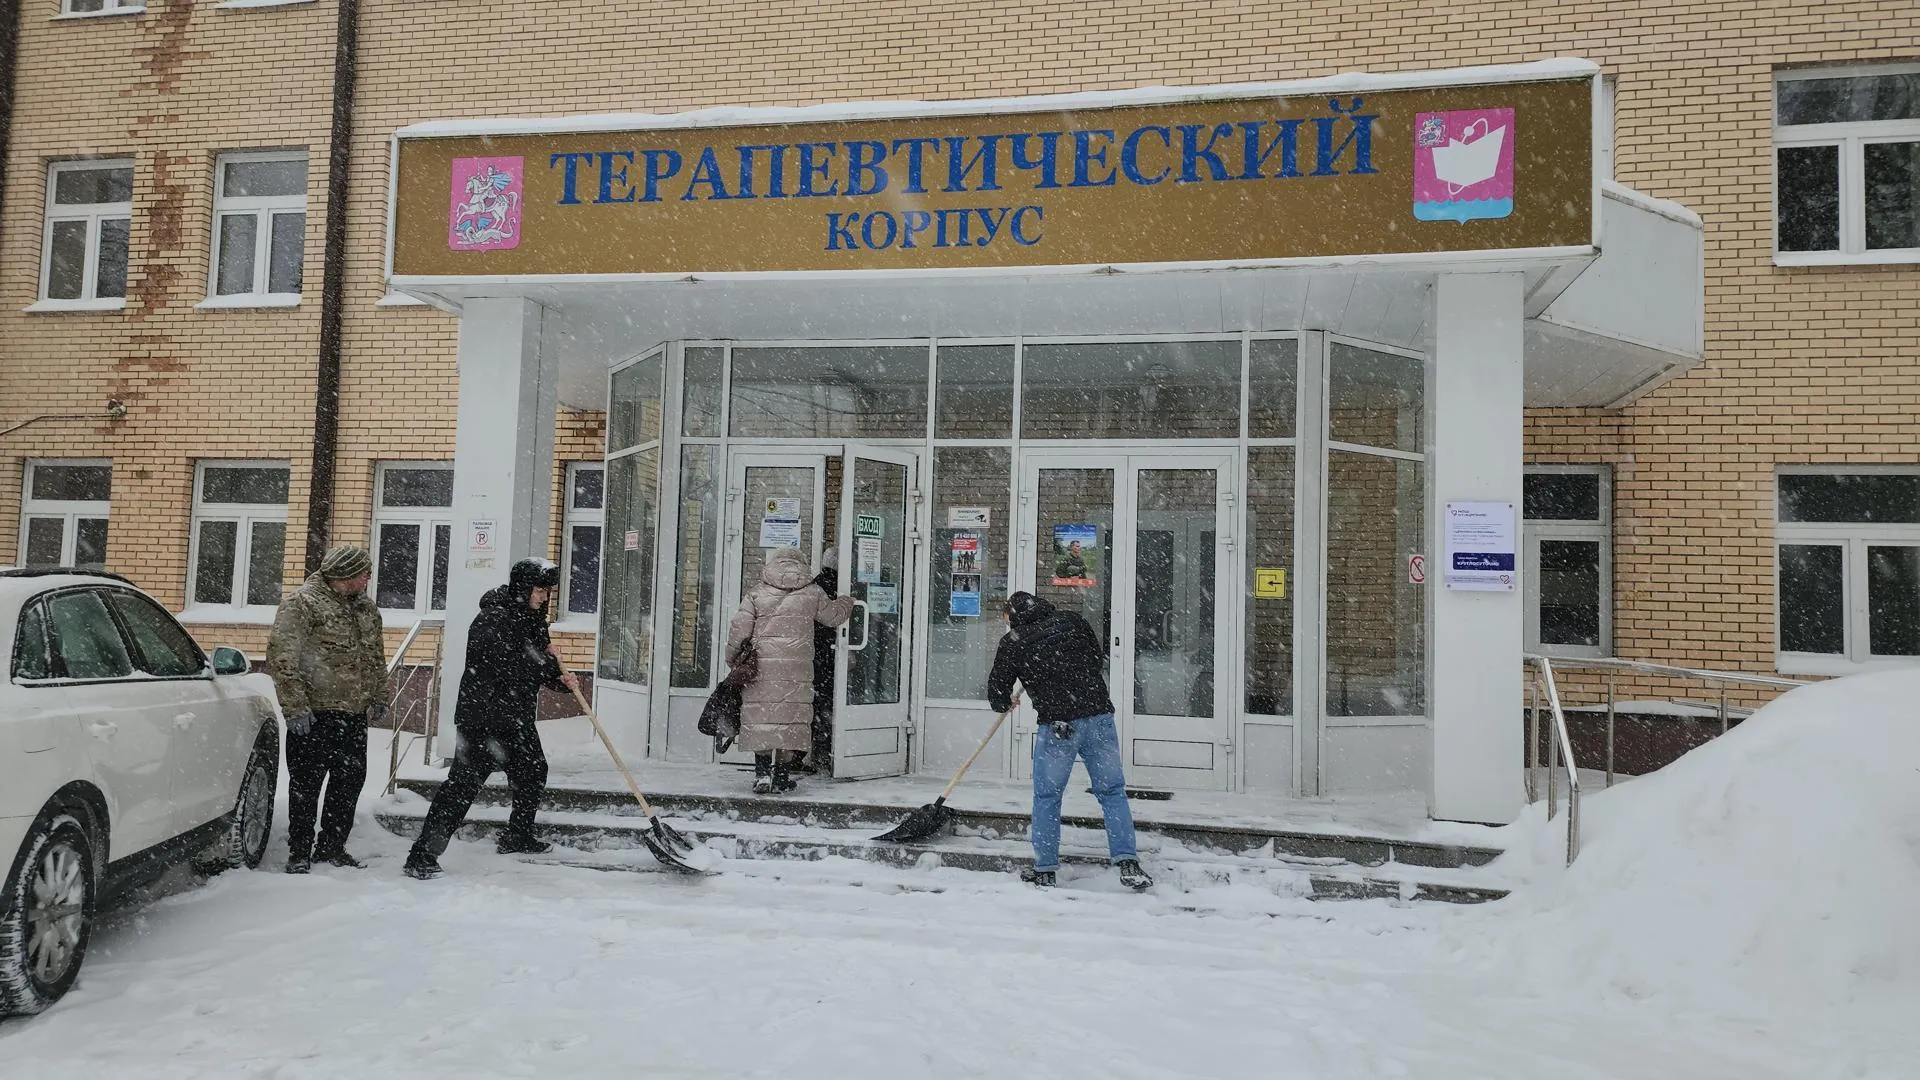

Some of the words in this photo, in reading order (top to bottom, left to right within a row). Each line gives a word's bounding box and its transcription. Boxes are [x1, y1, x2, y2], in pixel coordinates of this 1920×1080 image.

[550, 97, 1381, 205] ТЕРАПЕВТИЧЕСКИЙ
[824, 205, 1044, 251] КОРПУС
[858, 518, 879, 534] ВХОД
